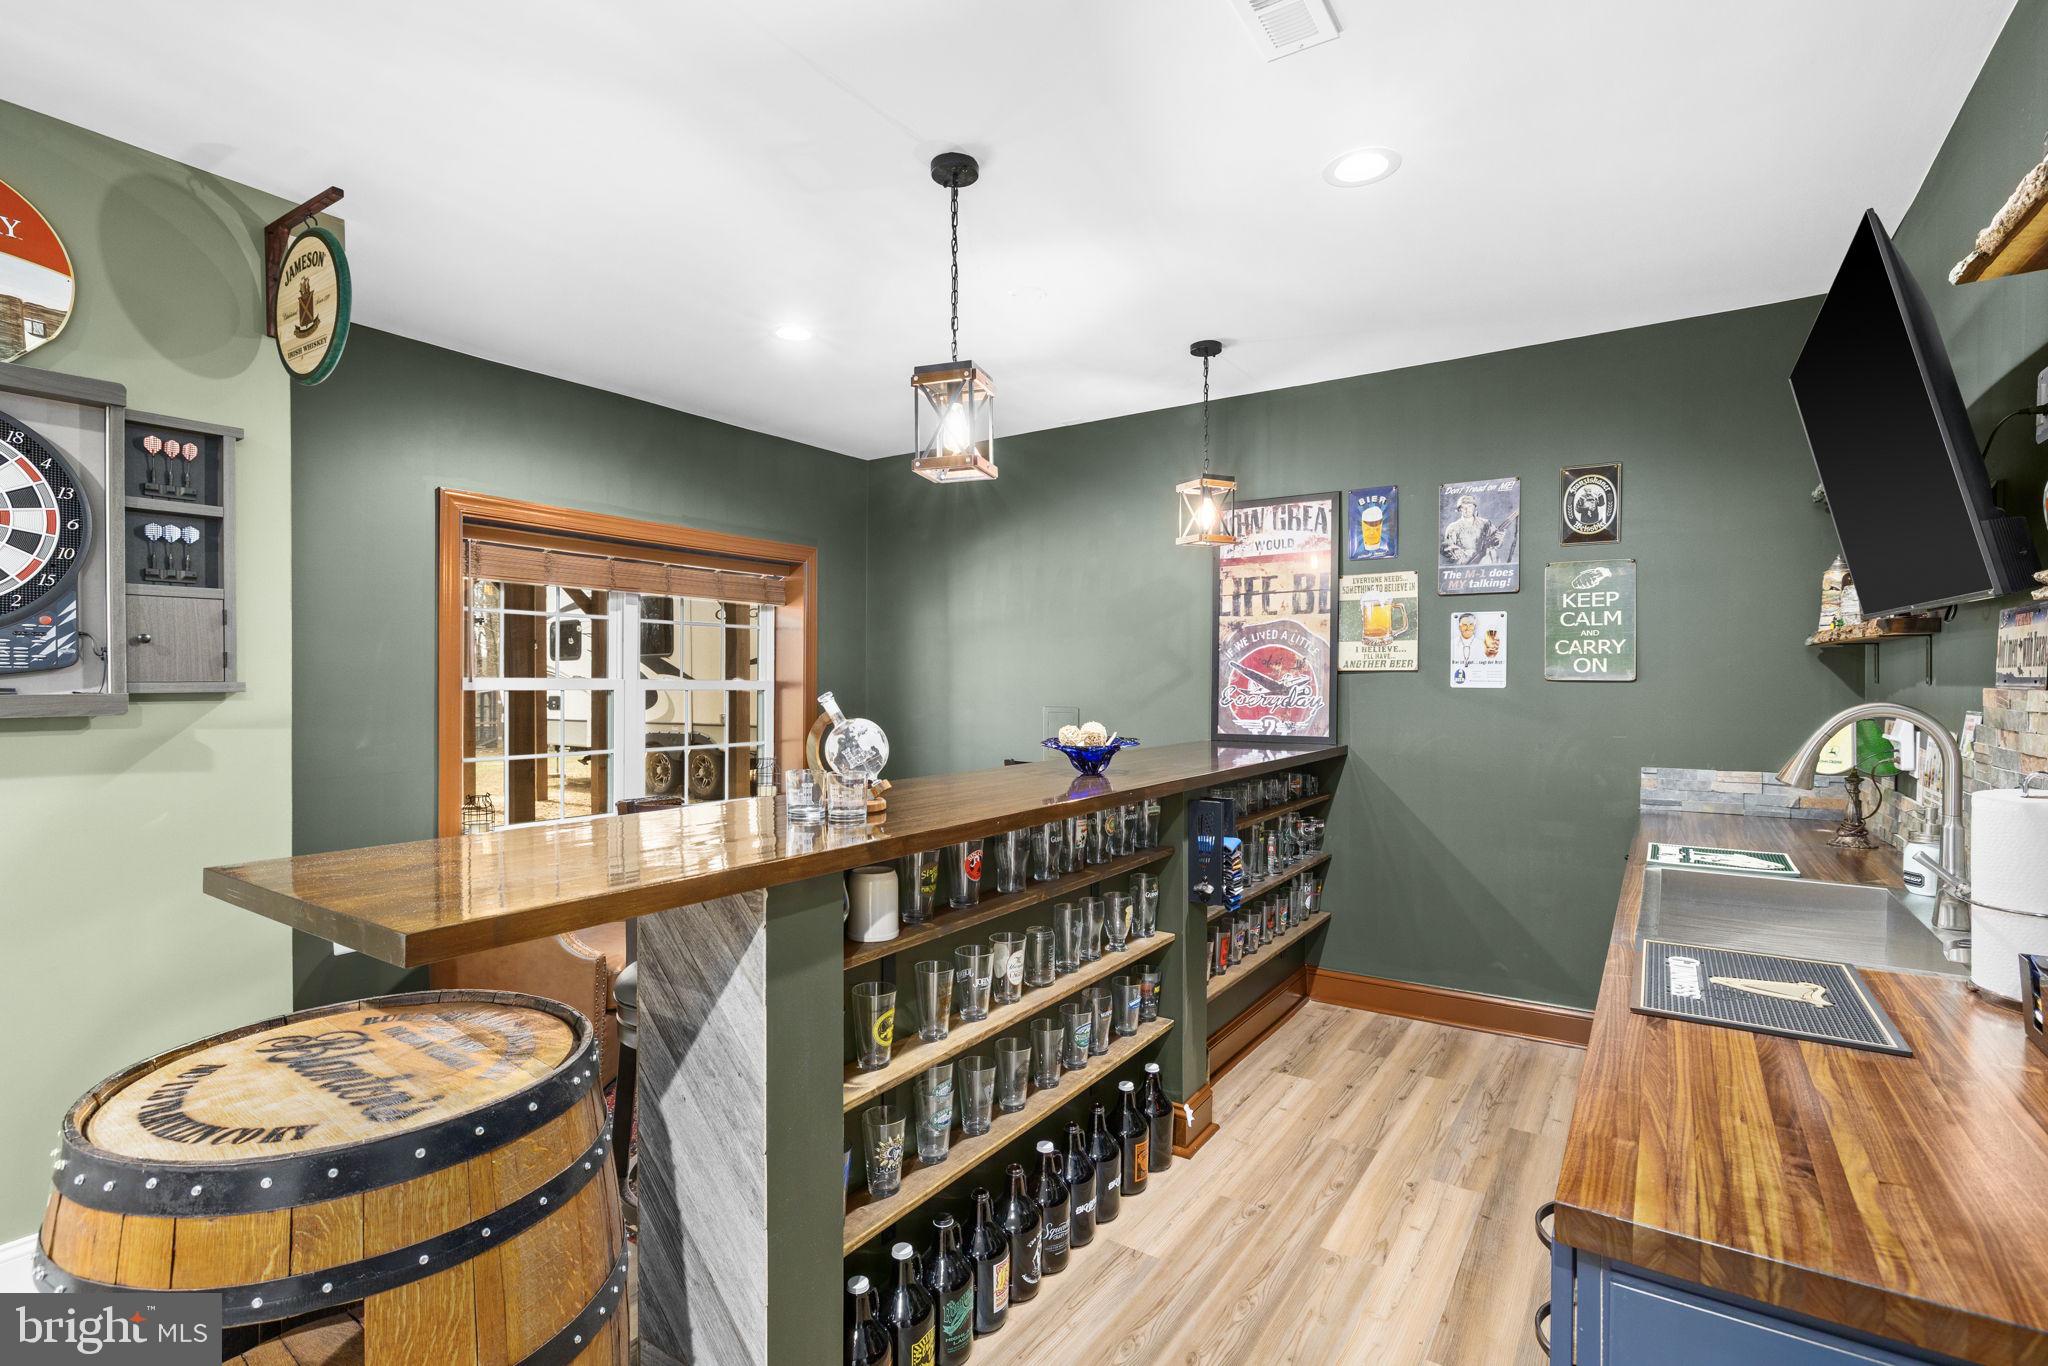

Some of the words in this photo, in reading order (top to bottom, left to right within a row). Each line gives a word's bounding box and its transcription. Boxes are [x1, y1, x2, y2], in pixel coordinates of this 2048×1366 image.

[284, 251, 326, 287] JAMESON
[287, 347, 302, 359] IRISH
[303, 337, 327, 352] WHISKEY
[6, 430, 25, 444] 18
[40, 457, 52, 469] 4
[56, 486, 74, 499] 13
[1487, 483, 1497, 491] on
[1358, 495, 1387, 506] BIER
[67, 519, 80, 530] 6
[1273, 503, 1328, 534] GREA
[1255, 538, 1295, 552] WOULD
[56, 547, 75, 560] 10
[38, 573, 56, 587] 15
[1443, 570, 1461, 579] The
[1465, 570, 1486, 578] M-1
[1489, 568, 1514, 577] does
[1342, 584, 1375, 594] SOMETHING
[1376, 584, 1383, 593] TO
[1384, 582, 1408, 592] BELIEVE
[1409, 582, 1416, 591] IN
[1448, 580, 1466, 589] MY
[1469, 577, 1511, 588] talking!
[11, 594, 22, 607] 2
[1562, 591, 1620, 608] KEEP
[1560, 610, 1622, 627] CALM
[1580, 629, 1600, 637] AND
[1225, 649, 1234, 659] IF
[1234, 637, 1249, 651] WE
[1251, 629, 1278, 641] LIVED
[1280, 631, 1287, 640] A
[1290, 632, 1320, 657] LITTLE
[1555, 639, 1627, 655] CARRY
[1342, 660, 1386, 668] ANOTHER
[1389, 659, 1414, 668] BEER
[1573, 657, 1608, 673] ON
[1220, 685, 1325, 714] Everyday
[256, 1030, 446, 1122] Blanton's
[137, 1098, 231, 1144] FRANKLIN
[211, 1127, 264, 1145] CO
[257, 1123, 320, 1144] KY
